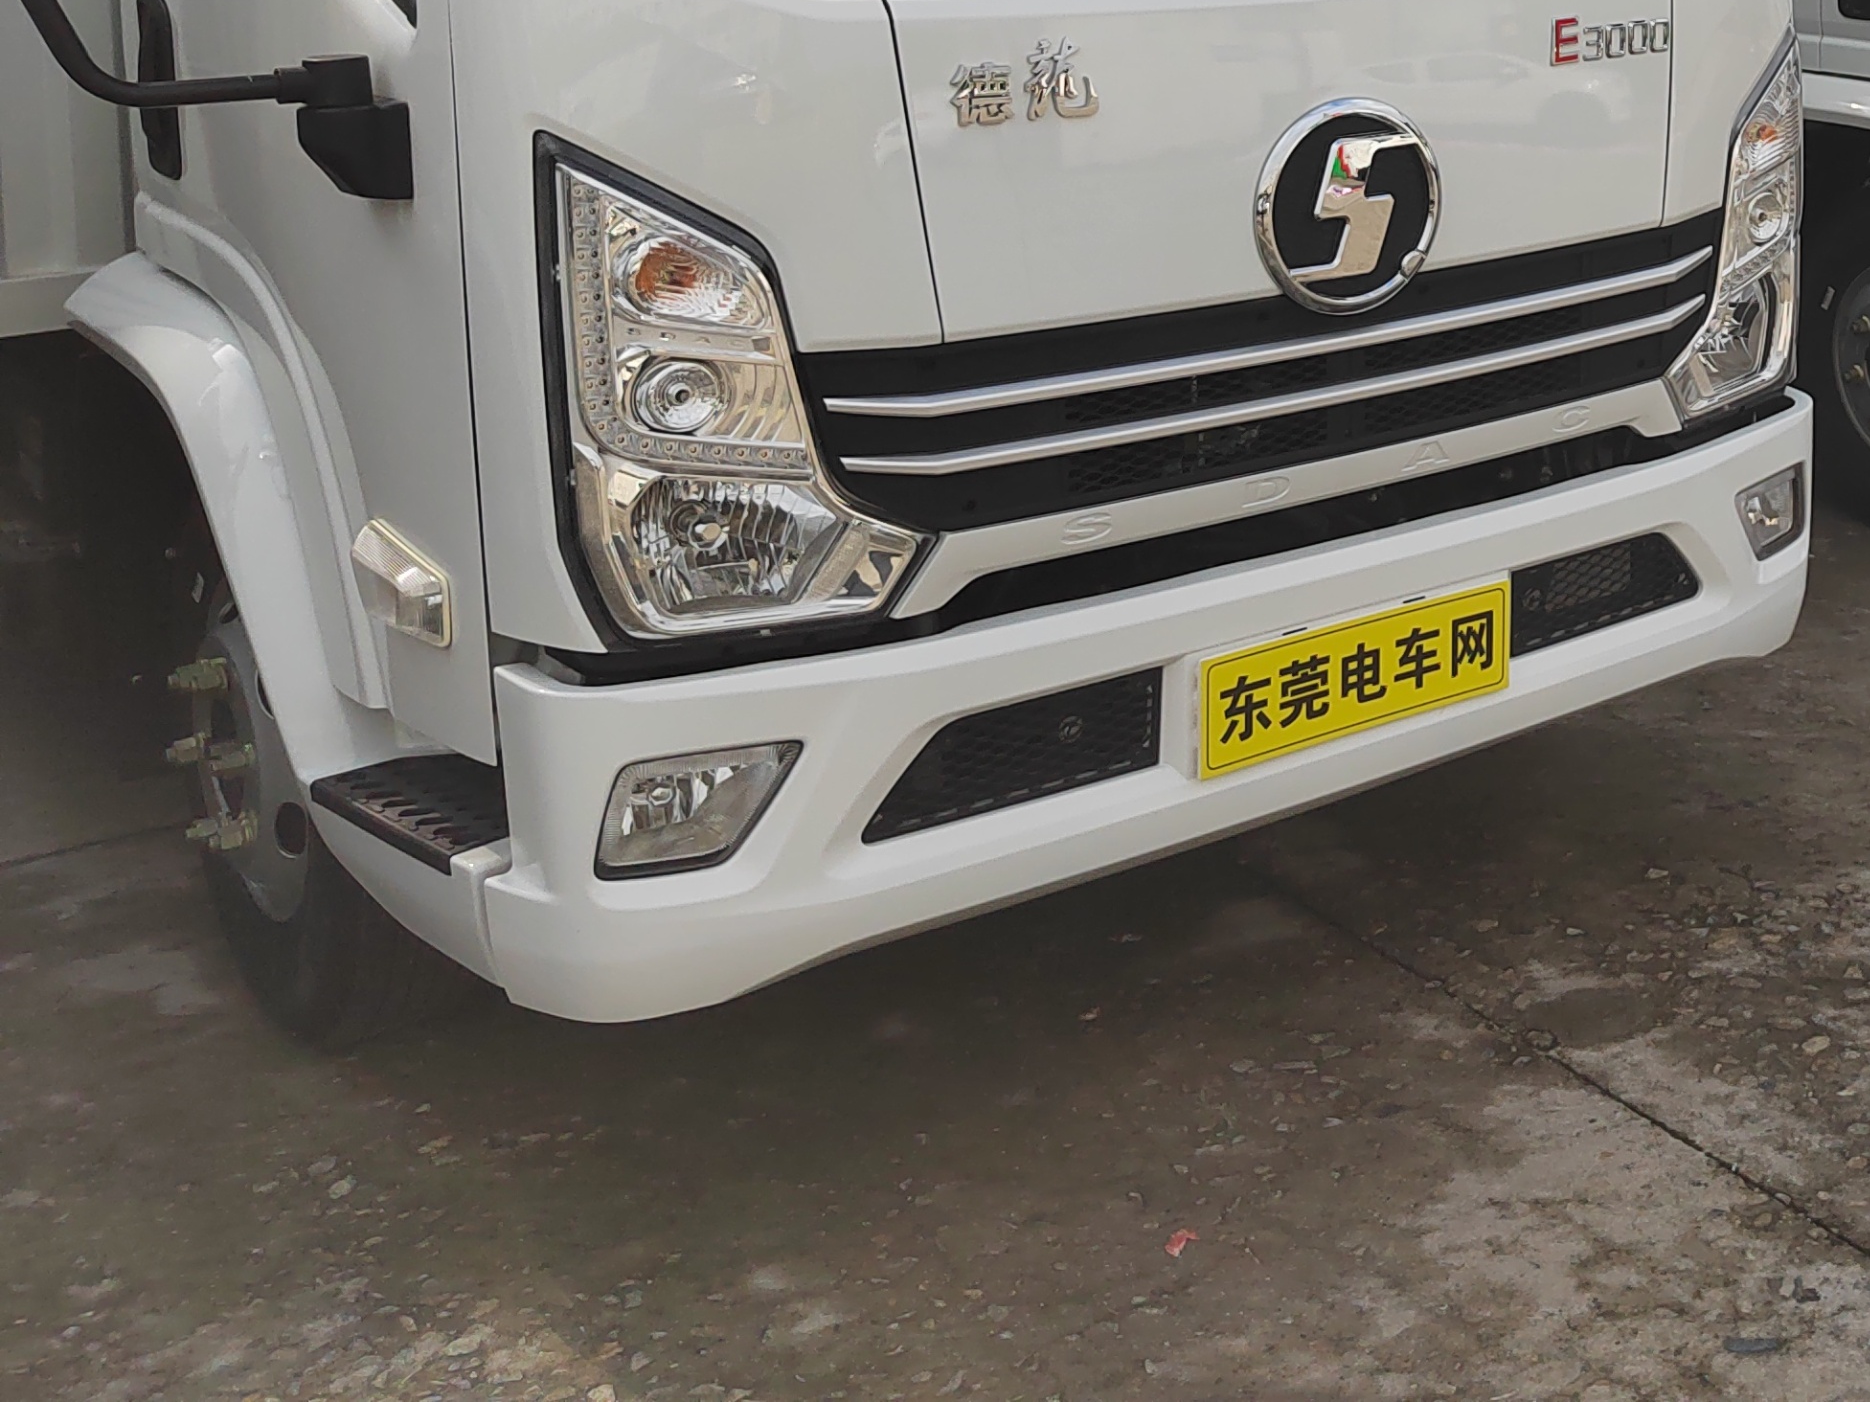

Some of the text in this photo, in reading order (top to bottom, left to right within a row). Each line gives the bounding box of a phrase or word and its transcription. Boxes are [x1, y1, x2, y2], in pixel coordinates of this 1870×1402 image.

[1550, 15, 1670, 67] E3000
[1219, 609, 1494, 745] 东莞电车网
